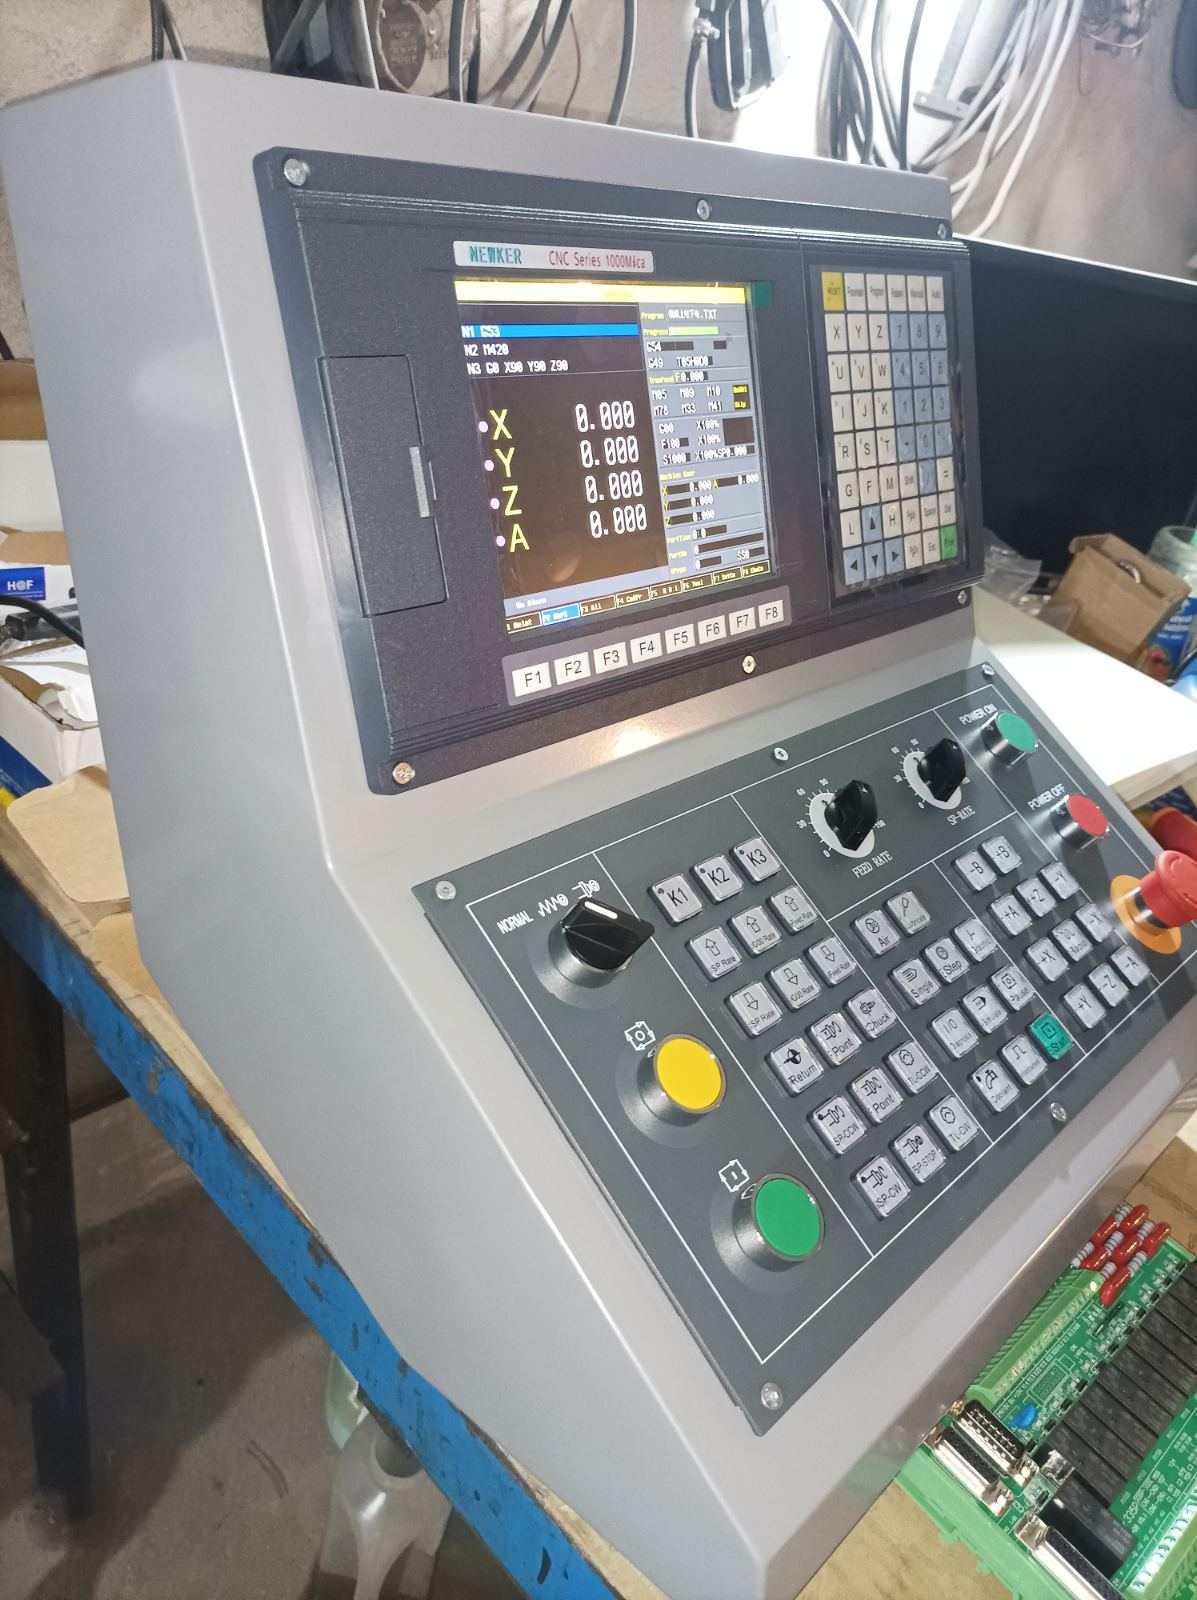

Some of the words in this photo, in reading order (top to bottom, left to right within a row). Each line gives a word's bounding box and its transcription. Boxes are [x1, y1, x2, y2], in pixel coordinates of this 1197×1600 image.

[469, 246, 523, 265] NEWKER
[549, 250, 570, 266] CNC
[574, 252, 601, 267] Series
[461, 325, 475, 338] N1
[833, 325, 840, 340] X
[855, 325, 862, 338] Y
[876, 325, 883, 338] Z
[464, 344, 479, 356] N2
[467, 362, 481, 375] N3
[550, 359, 569, 372] Z90
[836, 366, 844, 380] U
[858, 365, 865, 378] V
[879, 364, 887, 377] W
[881, 402, 888, 416] K
[489, 409, 513, 440] X
[575, 400, 635, 432] 0.000
[842, 445, 849, 459] R
[864, 442, 871, 456] S
[884, 439, 890, 452] T
[494, 447, 515, 478] Y
[579, 435, 639, 468] 0.000
[845, 483, 852, 497] G
[866, 480, 872, 494] F
[886, 477, 894, 490] M
[502, 485, 522, 516] Z
[584, 470, 643, 504] 0.000
[889, 513, 896, 526] H
[510, 523, 530, 552] A
[589, 503, 647, 538] 0.000
[848, 522, 854, 535] L
[765, 605, 778, 620] F8
[736, 613, 750, 628] F7
[706, 622, 720, 637] F6
[673, 630, 689, 645] F5
[639, 640, 656, 655] F4
[603, 649, 620, 665] F3
[564, 661, 582, 676] F2
[524, 671, 543, 688] F1
[959, 709, 983, 725] POWER
[984, 703, 998, 715] ON
[1028, 792, 1053, 811] POWER
[1052, 784, 1066, 798] OFF
[746, 848, 768, 868] K3
[852, 860, 873, 878] FEED
[873, 850, 893, 867] RATE
[707, 867, 730, 887] K2
[666, 887, 689, 907] K1
[497, 909, 534, 935] NORMAL
[878, 935, 891, 947] Air
[943, 961, 963, 976] Step
[865, 1014, 890, 1033] Chuck
[788, 1063, 818, 1085] Return
